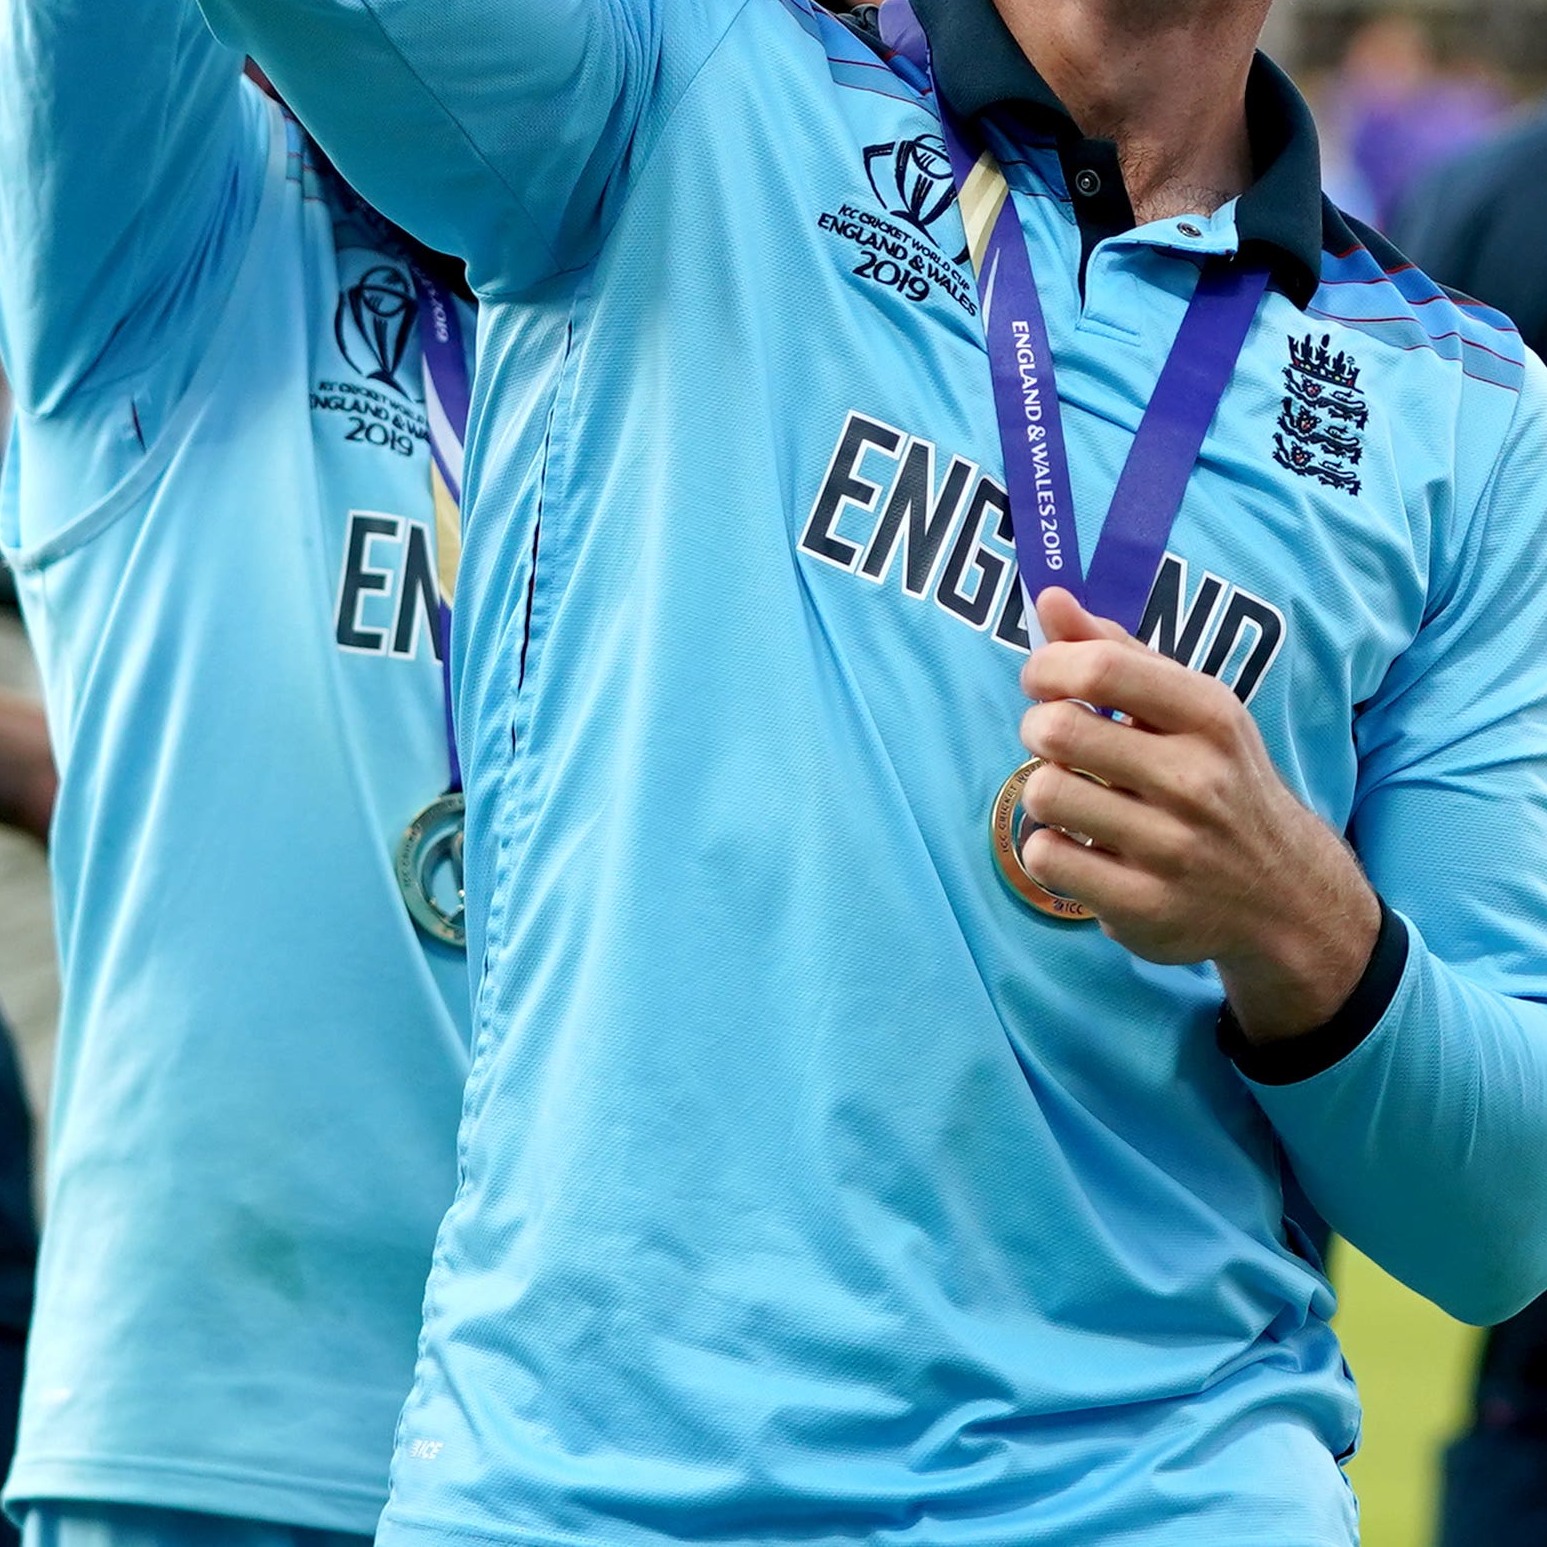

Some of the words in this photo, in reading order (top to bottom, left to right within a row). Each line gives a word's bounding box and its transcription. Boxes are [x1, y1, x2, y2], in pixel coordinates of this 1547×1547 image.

[818, 212, 908, 261] ENGLAND
[908, 254, 925, 274] &
[927, 261, 978, 317] WALES
[838, 204, 860, 220] ICC
[859, 212, 911, 243] CRICKET
[911, 237, 951, 271] WORLD
[951, 269, 971, 290] CUP
[852, 250, 930, 302] 2019
[1011, 320, 1043, 422] ENGLAND
[344, 416, 414, 457] 2019
[1027, 423, 1046, 442] &
[1030, 442, 1056, 517] WALES
[1040, 518, 1064, 571] 2019
[1065, 903, 1083, 915] ICC
